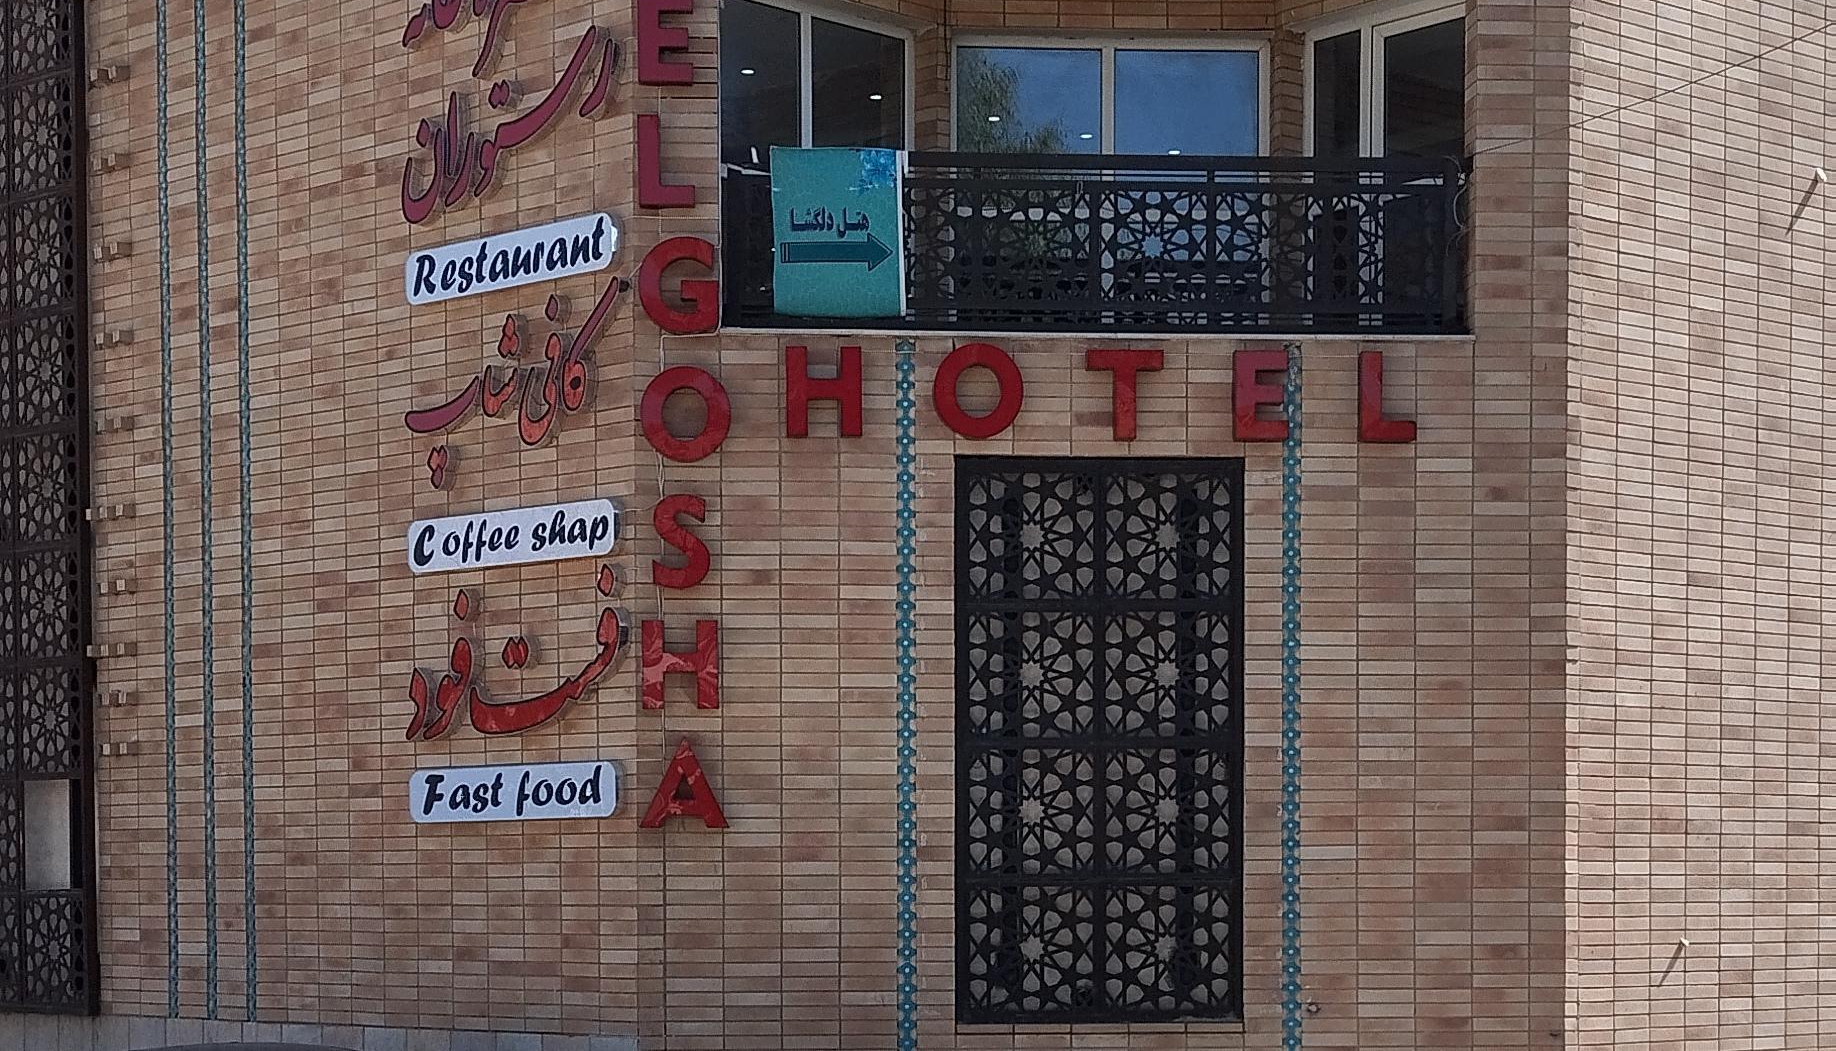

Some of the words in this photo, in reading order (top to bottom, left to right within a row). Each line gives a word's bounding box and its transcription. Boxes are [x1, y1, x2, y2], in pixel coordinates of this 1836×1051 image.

[402, 25, 615, 224] رستوران
[413, 215, 606, 297] Restaurant
[789, 205, 834, 233] دلگشا
[836, 206, 871, 238] هتل
[785, 343, 1418, 443] HOTEL
[413, 519, 520, 567] Coffee
[531, 509, 610, 551] shap
[405, 588, 472, 741] فود
[469, 563, 619, 735] فست
[422, 772, 504, 816] Fast
[516, 764, 603, 817] food
